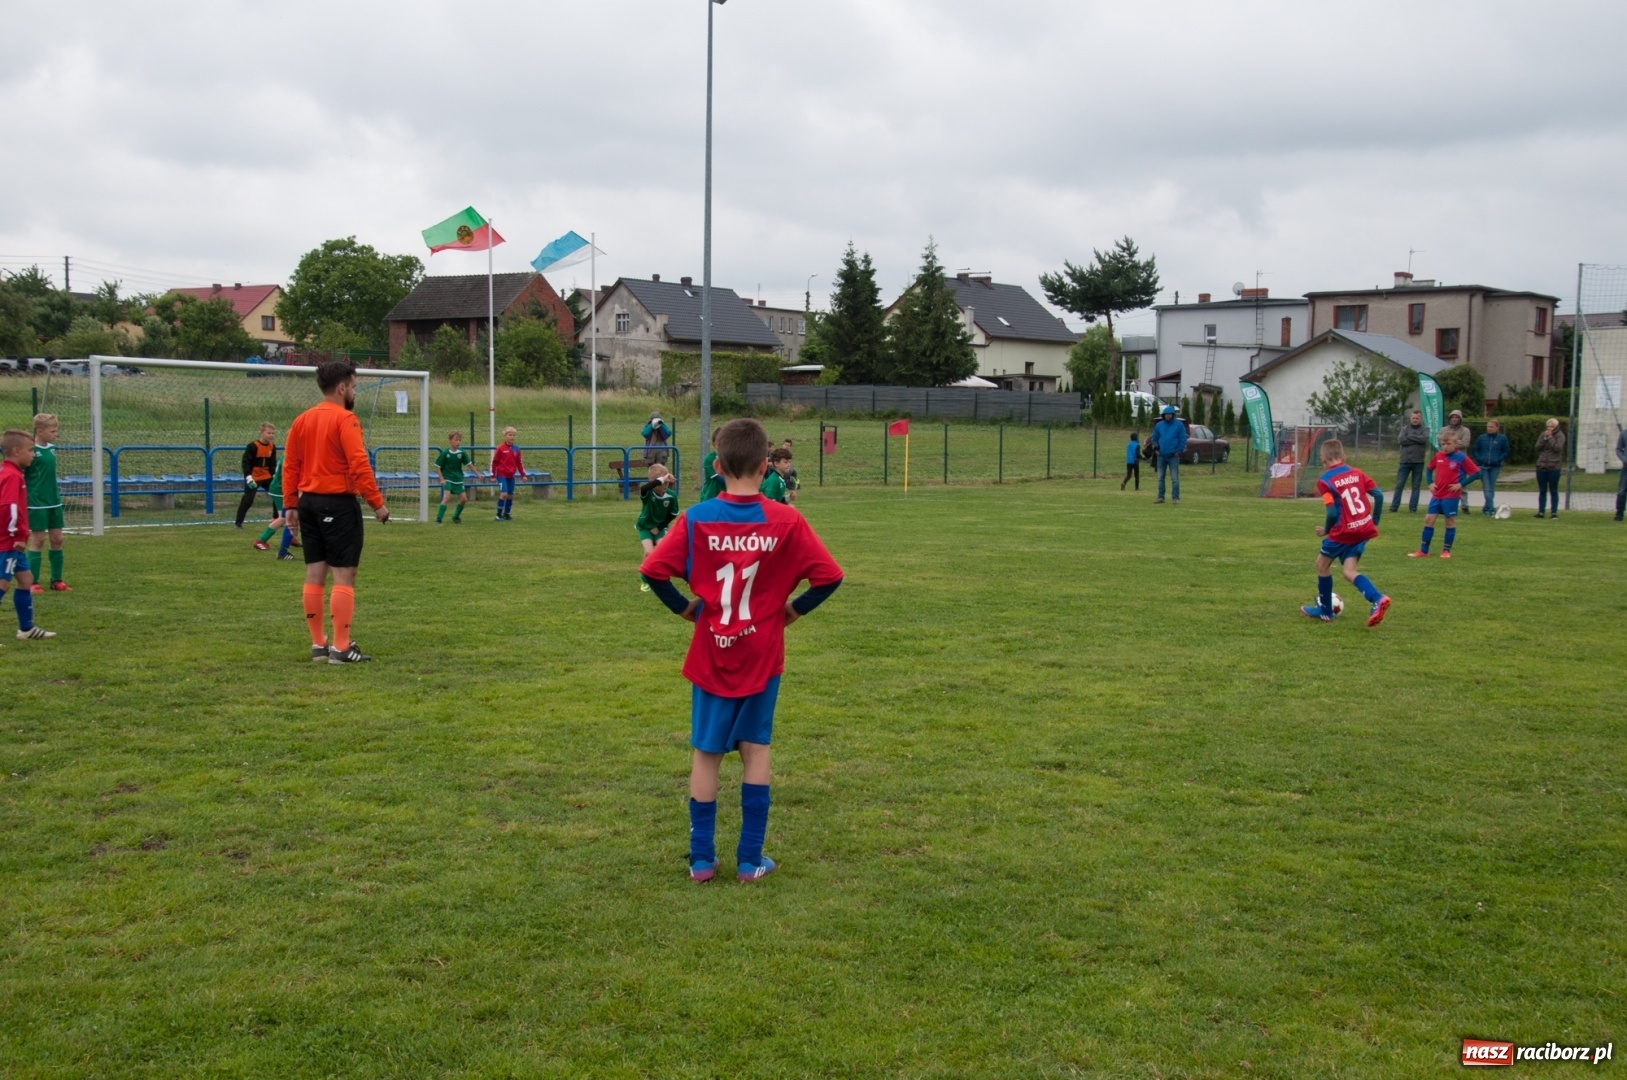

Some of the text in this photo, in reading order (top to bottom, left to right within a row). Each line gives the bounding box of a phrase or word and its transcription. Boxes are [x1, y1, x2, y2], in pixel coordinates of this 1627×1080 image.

[1334, 475, 1360, 488] RAKÓW
[1341, 486, 1366, 516] 13
[708, 532, 778, 552] RAKÓW
[716, 560, 760, 626] 11
